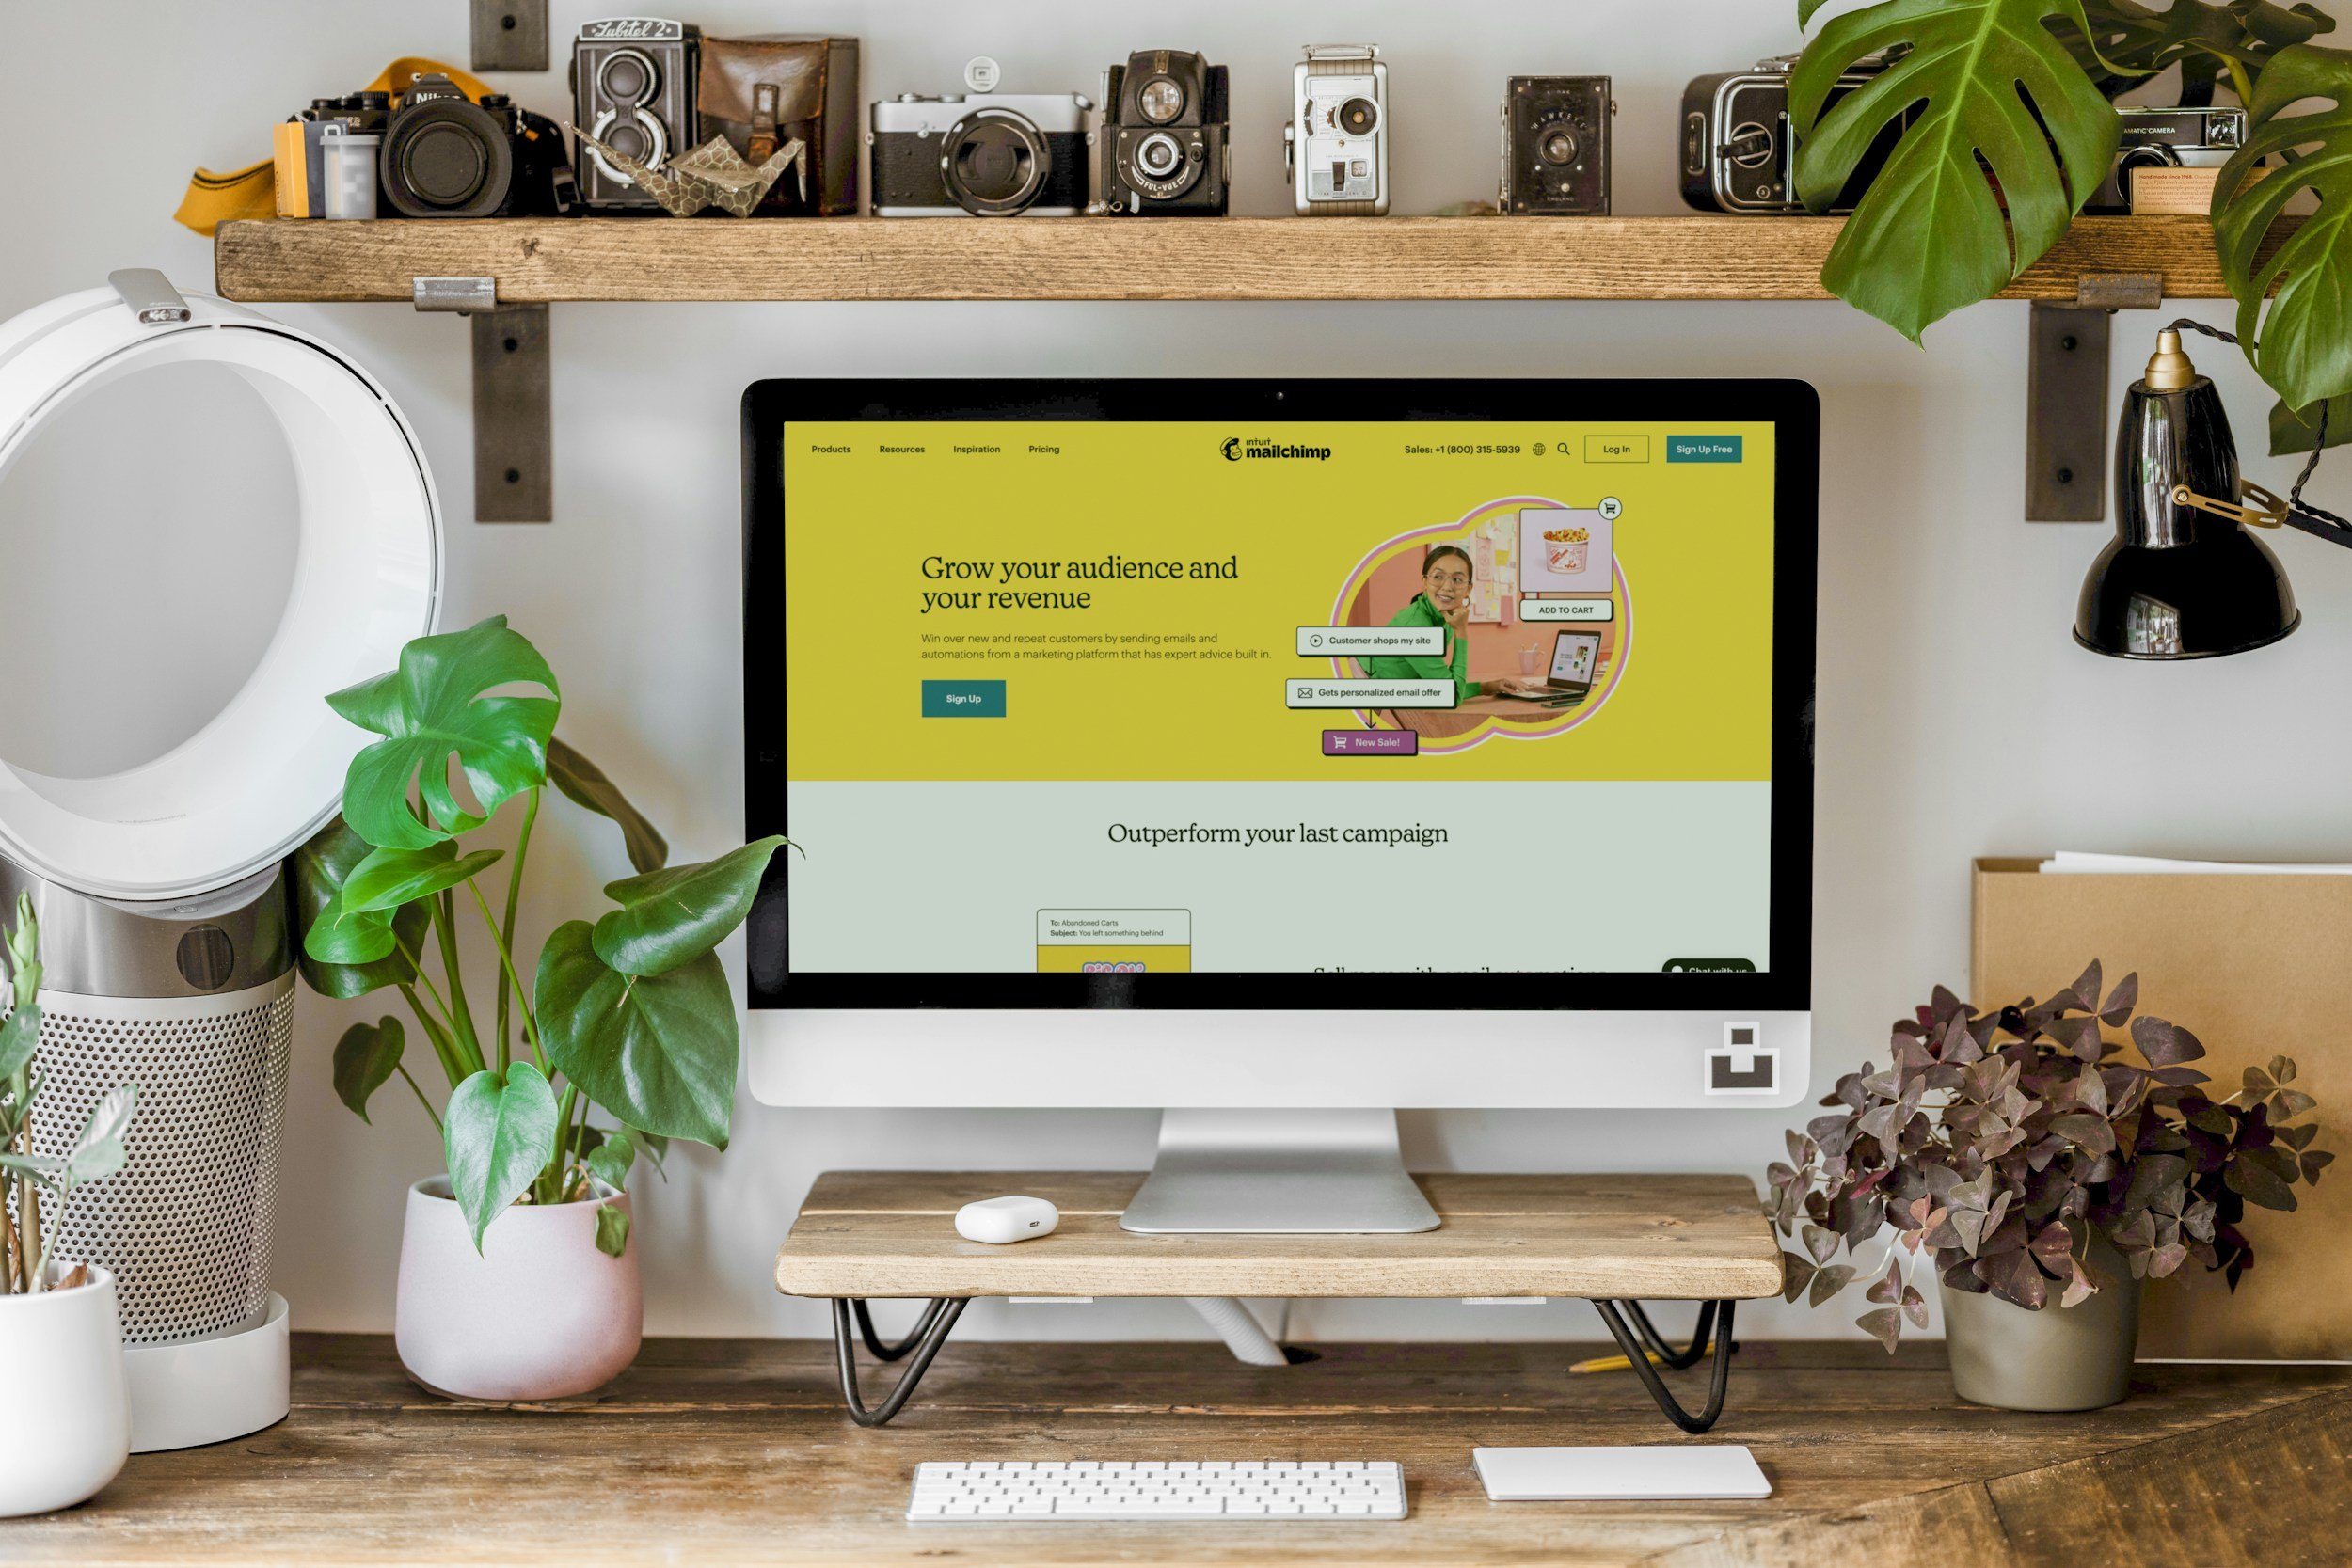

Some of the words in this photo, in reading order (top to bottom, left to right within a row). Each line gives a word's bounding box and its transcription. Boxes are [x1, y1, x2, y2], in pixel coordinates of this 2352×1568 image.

[594, 20, 654, 38] Lubitel
[655, 21, 666, 37] 2
[1143, 182, 1179, 191] FUL-VUE
[1246, 437, 1272, 446] intuit
[811, 444, 851, 453] Products
[879, 445, 926, 453] Resources
[953, 444, 1001, 455] Inspiration
[1028, 445, 1060, 455] Pricing
[1245, 444, 1332, 461] mailchimp
[1404, 444, 1433, 454] Sales:
[1435, 445, 1445, 454] +1
[1446, 444, 1474, 455] (800)
[1475, 445, 1521, 454] 315-5939
[1603, 445, 1621, 455] Log
[1622, 445, 1631, 453] In
[1676, 444, 1697, 455] Sign
[1698, 445, 1712, 455] Up
[1713, 444, 1733, 454] Free
[921, 556, 995, 579] Grow
[999, 562, 1062, 585] your
[1066, 554, 1184, 579] audience
[1188, 554, 1239, 579] and
[920, 592, 982, 614] your
[987, 592, 1091, 610] revenue
[1538, 606, 1557, 614] ADD
[1558, 606, 1570, 614] TO
[1570, 606, 1594, 614] CART
[921, 633, 941, 643] Win
[943, 635, 966, 643] over
[967, 635, 990, 643] new
[992, 633, 1011, 643] and
[1013, 634, 1047, 645] repeat
[1048, 634, 1104, 643] customers
[1104, 633, 1119, 645] by
[1120, 633, 1161, 645] sending
[1163, 633, 1197, 643] emails
[1198, 633, 1218, 643] and
[1328, 636, 1372, 645] Customer
[1373, 636, 1399, 647] shops
[1400, 638, 1414, 647] my
[1415, 636, 1431, 645] site
[921, 649, 985, 659] automations
[987, 648, 1011, 659] from
[1013, 651, 1021, 659] a
[1022, 649, 1073, 661] marketing
[1075, 648, 1120, 661] platform
[1120, 649, 1142, 659] that
[1144, 648, 1163, 659] has
[1164, 650, 1198, 661] expert
[1199, 649, 1233, 659] advice
[1235, 648, 1258, 659] built
[1260, 649, 1272, 659] in.
[1318, 688, 1339, 697] Gets
[1340, 688, 1395, 699] personalized
[1395, 688, 1420, 697] email
[1421, 688, 1442, 697] offer
[946, 694, 967, 705] Sign
[968, 694, 982, 705] Up
[1355, 737, 1376, 747] New
[1377, 737, 1401, 747] Sale!
[1107, 822, 1241, 847] Outperform
[1244, 828, 1295, 847] your
[1298, 822, 1339, 843] last
[1342, 822, 1449, 847] campaign
